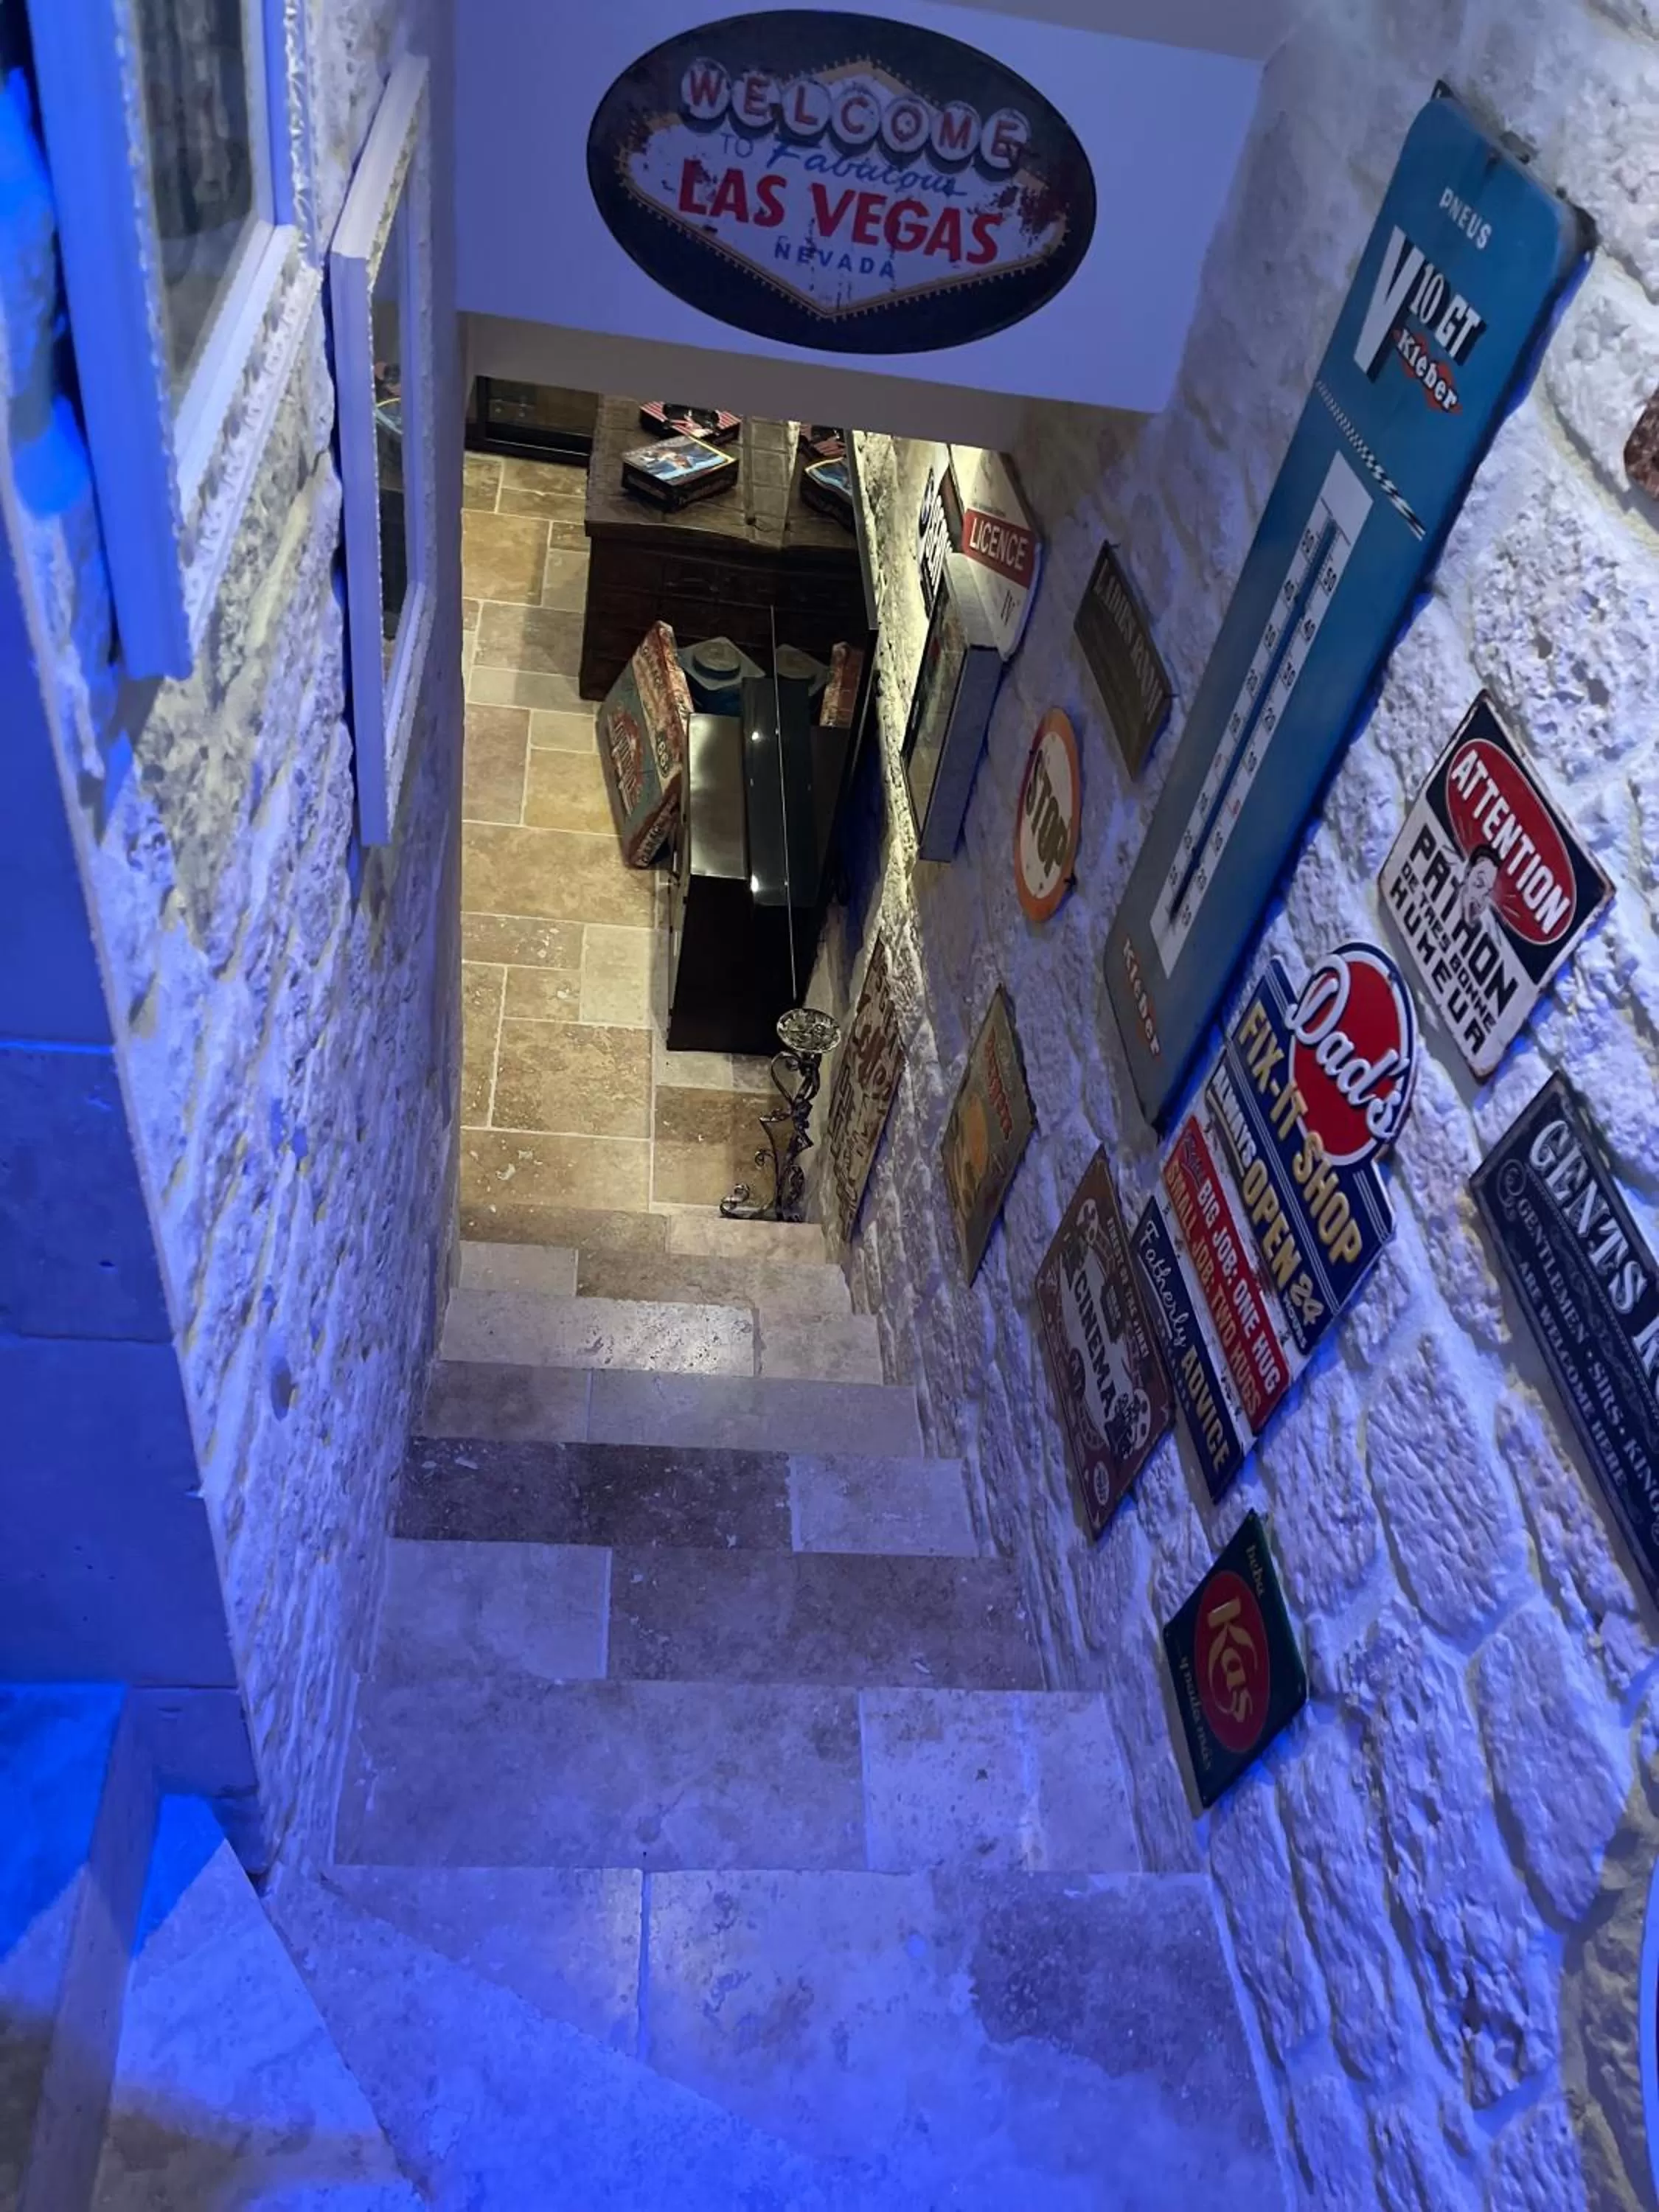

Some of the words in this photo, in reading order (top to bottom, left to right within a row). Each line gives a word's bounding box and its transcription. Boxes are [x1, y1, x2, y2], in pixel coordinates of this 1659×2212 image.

[684, 66, 1023, 160] WELCOME
[722, 133, 754, 159] TO
[766, 139, 967, 198] Fabulous
[678, 158, 787, 228] LAS
[810, 182, 1003, 265] VEGAS
[774, 241, 896, 279] NEVADA
[1439, 187, 1492, 251] PNEUS
[1398, 328, 1458, 410] Kleber
[968, 516, 1029, 571] LICENCE
[1026, 748, 1068, 878] STOP
[1450, 748, 1571, 936] ATTENTION
[1122, 937, 1161, 1055] Kleber
[1390, 876, 1486, 1056] HUMEUR
[1402, 860, 1420, 893] DE
[1419, 890, 1452, 953] TRES
[1449, 953, 1497, 1034] BONNE
[1410, 822, 1519, 1018] PATRON
[1284, 953, 1410, 1139] Dad's
[1211, 1065, 1256, 1168] ALWAYS
[1242, 1158, 1302, 1292] OPEN
[1290, 1271, 1325, 1326] 24
[1239, 1001, 1308, 1141] FIX-IT
[1293, 1130, 1363, 1266] SHOP
[1529, 1119, 1649, 1315] GENTS
[1074, 1279, 1116, 1417] CINEMA
[1139, 1219, 1190, 1349] Fatherly
[1181, 1344, 1231, 1474] ADVICE
[1167, 1158, 1198, 1243] SMALL
[1191, 1234, 1215, 1293] JOB:
[1210, 1282, 1239, 1349] TWO
[1229, 1339, 1262, 1416] HUGS
[1197, 1178, 1221, 1230] BIG
[1212, 1225, 1239, 1286] JOB:
[1232, 1278, 1260, 1339] ONE
[1252, 1329, 1281, 1396] HUG
[1283, 1290, 1308, 1350] HOURS
[1517, 1197, 1587, 1345] GENTLEMEN
[1587, 1360, 1624, 1427] SIRS
[1518, 1260, 1543, 1304] ARE
[1539, 1303, 1596, 1421] WELCOME
[1590, 1419, 1627, 1488] HERE
[1207, 1596, 1259, 1724] Kas
